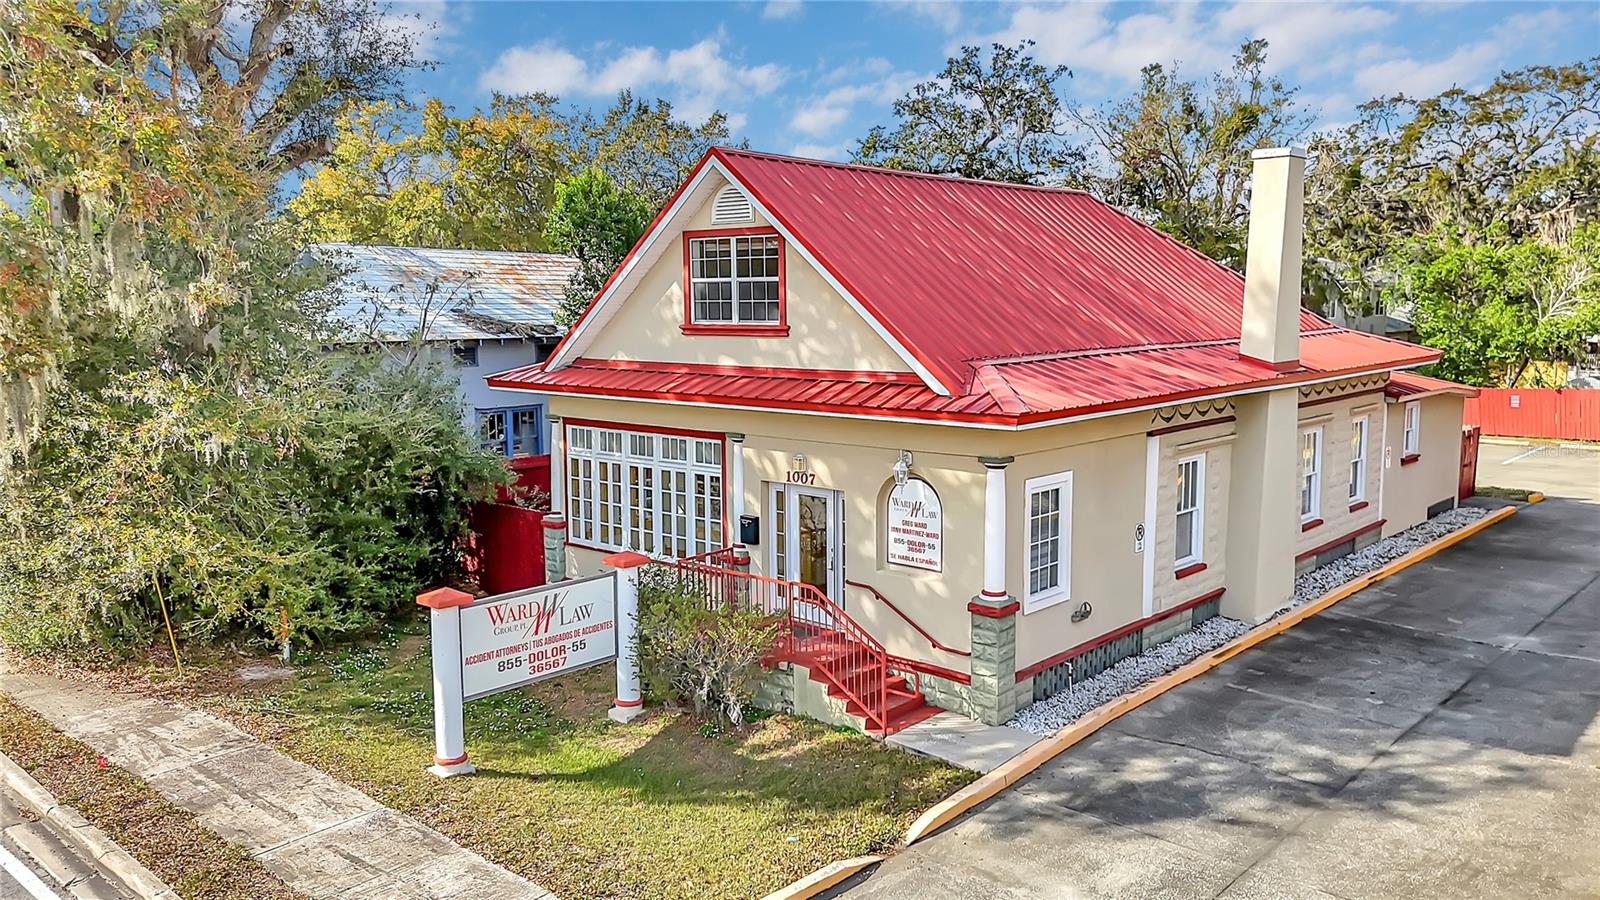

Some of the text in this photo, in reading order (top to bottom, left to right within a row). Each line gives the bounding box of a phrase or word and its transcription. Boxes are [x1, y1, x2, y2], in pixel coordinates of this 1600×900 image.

[786, 471, 816, 485] 1007
[892, 497, 913, 509] WARD
[922, 508, 939, 519] LAW
[902, 520, 927, 530] GREG WARD
[894, 538, 936, 550] 855-DOLOR-55
[485, 601, 540, 626] WARD
[560, 603, 594, 626] LAW
[465, 620, 613, 666] ACCIDENT ATTORNEYS TUS ABOGADOS DE ACCIDENTES
[497, 639, 587, 672] 855-DOLOR-55
[529, 656, 567, 675] 36567
